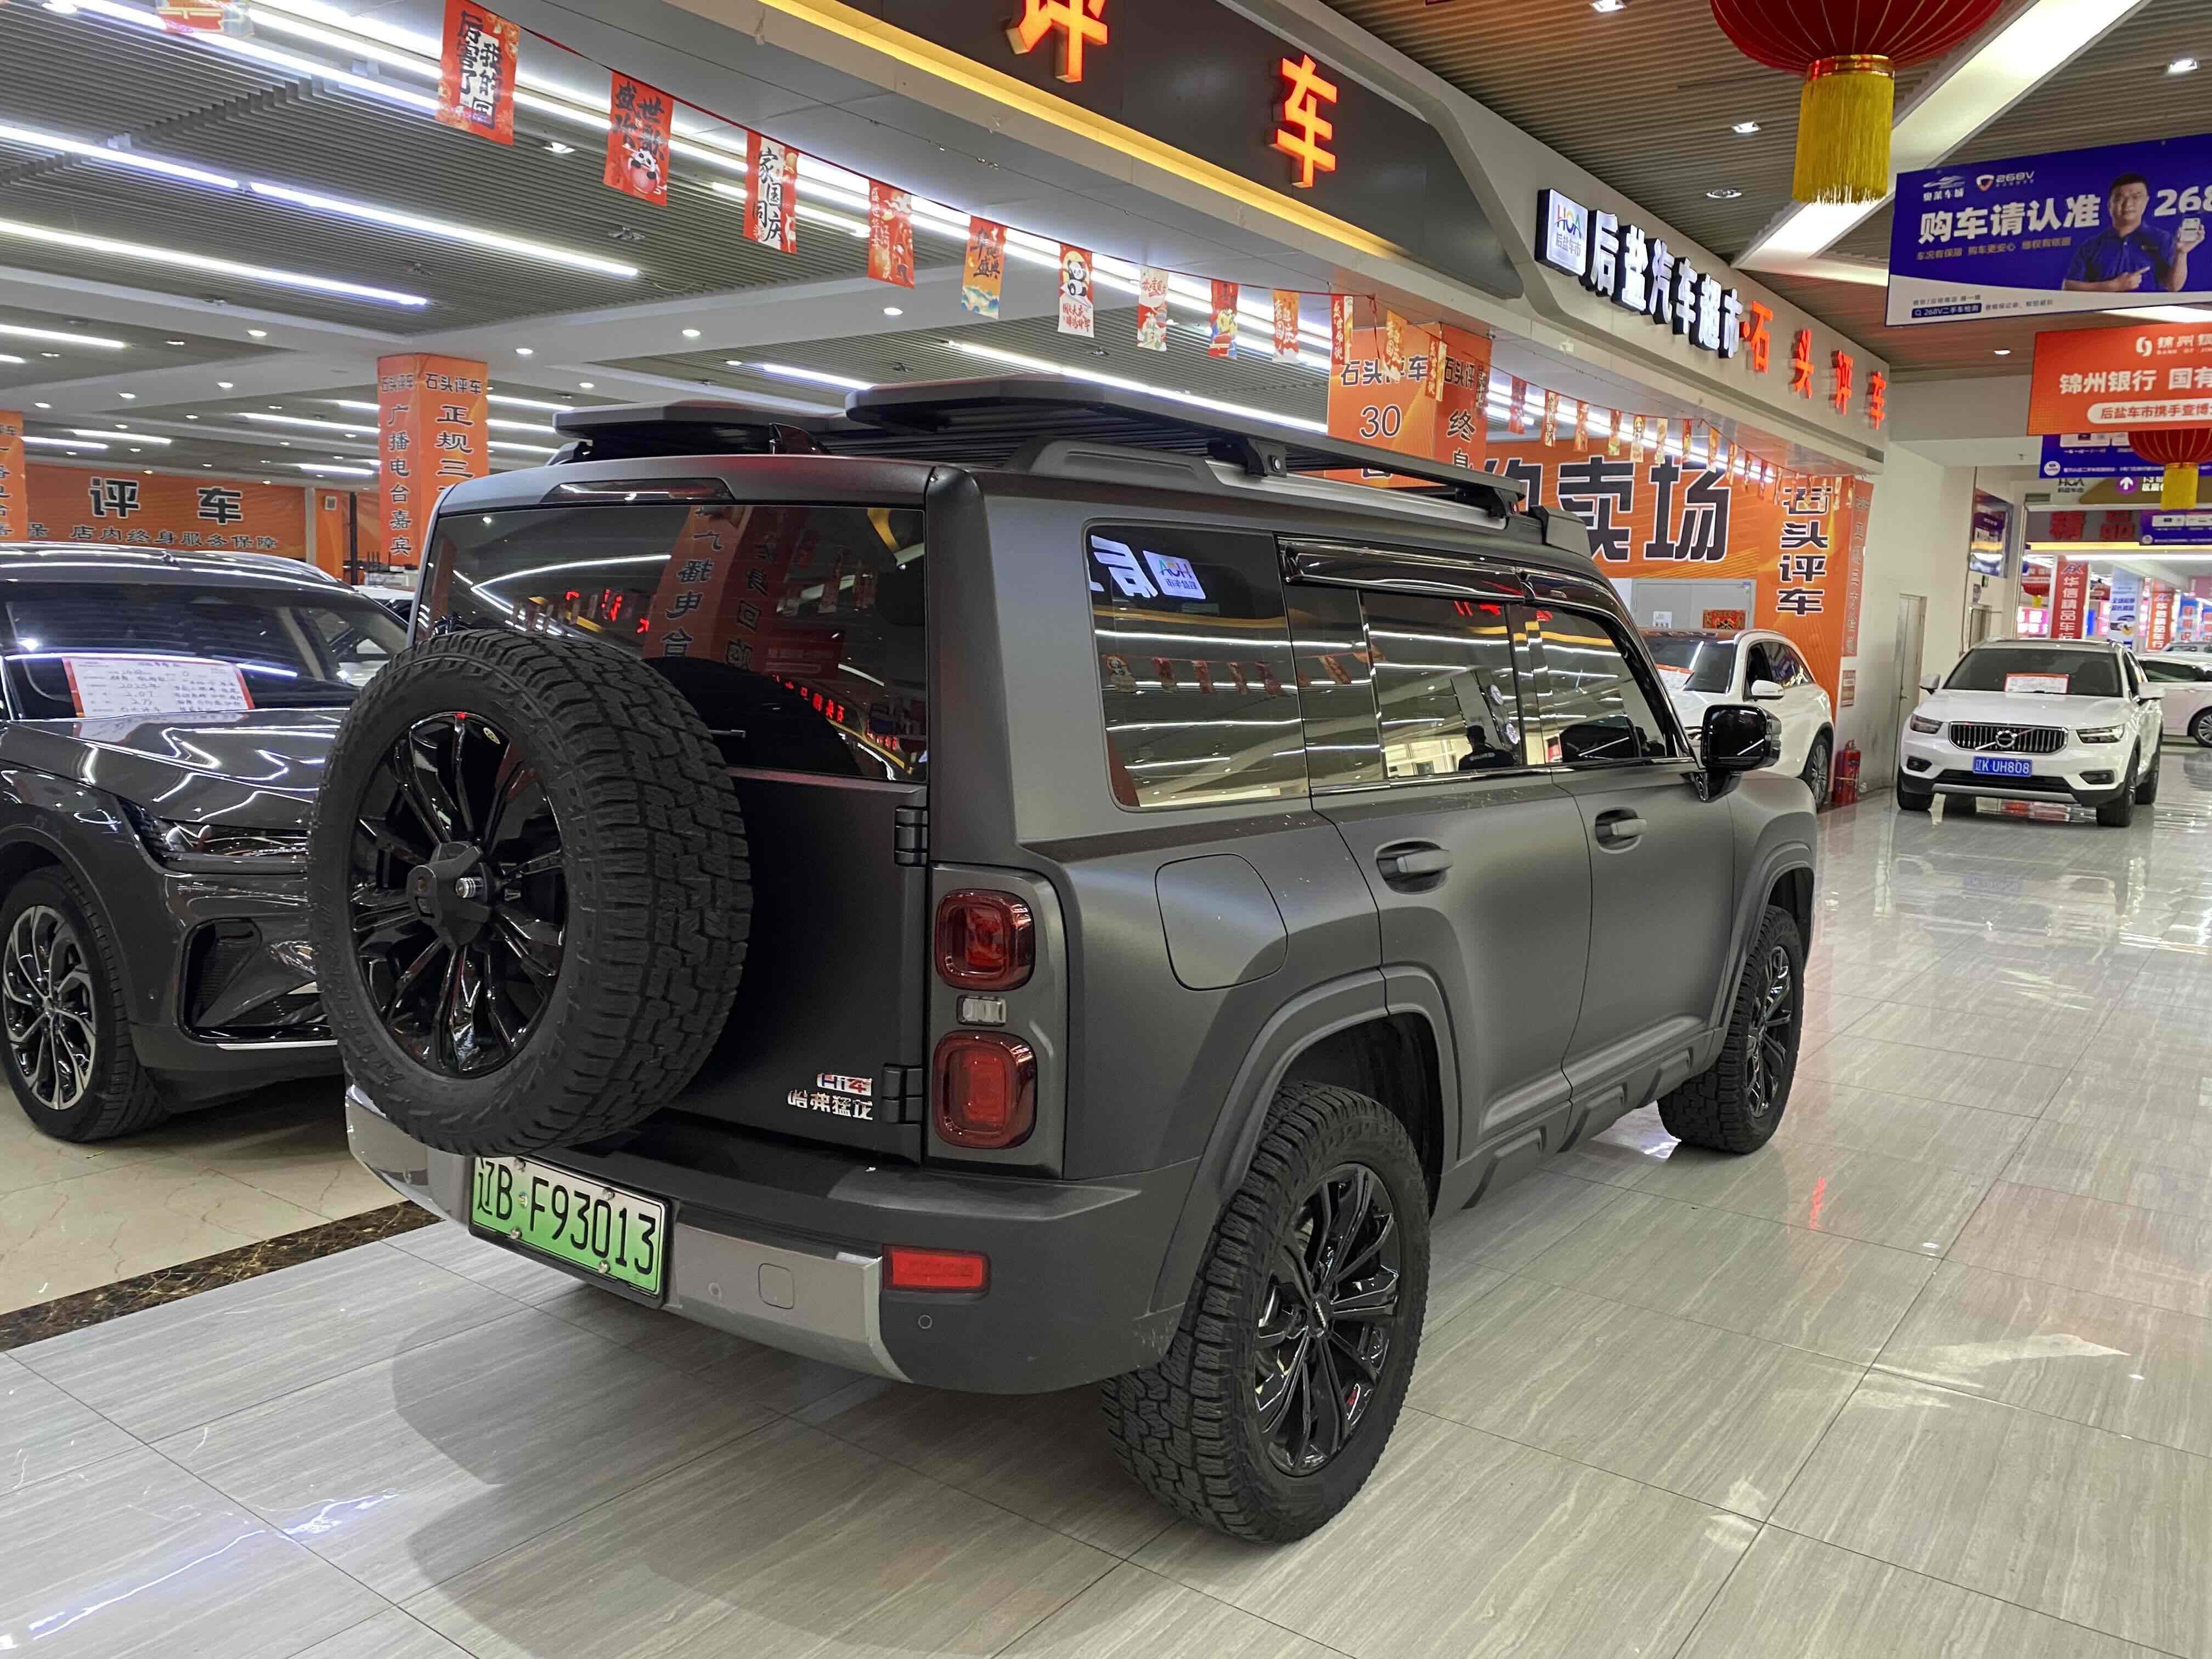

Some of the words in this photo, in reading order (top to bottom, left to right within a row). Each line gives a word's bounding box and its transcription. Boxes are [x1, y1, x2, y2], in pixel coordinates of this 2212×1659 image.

[1918, 194, 2101, 245] 购车请认准
[1555, 233, 1581, 257] 后盐车市
[1590, 210, 1743, 359] 后盐汽车超市
[1750, 300, 1886, 430] 石头评车
[425, 373, 482, 395] 石头评车
[1340, 355, 1428, 386] 石头车
[2059, 369, 2157, 394] 锦州银行
[2168, 366, 2212, 390] 国有
[1360, 404, 1401, 438] 30
[2101, 403, 2212, 420] 后盐车市携手壹博
[435, 405, 473, 493] 正规三
[387, 405, 411, 557] 广播电台嘉宾
[88, 476, 243, 525] 评车
[71, 526, 277, 549] 店内终身服务保障
[1775, 486, 1833, 617] 石头评车
[1992, 760, 2030, 774] UH808
[820, 1073, 868, 1094] Hi4
[787, 1089, 873, 1121] 哈弗猛龙
[529, 1176, 656, 1276] F93013
